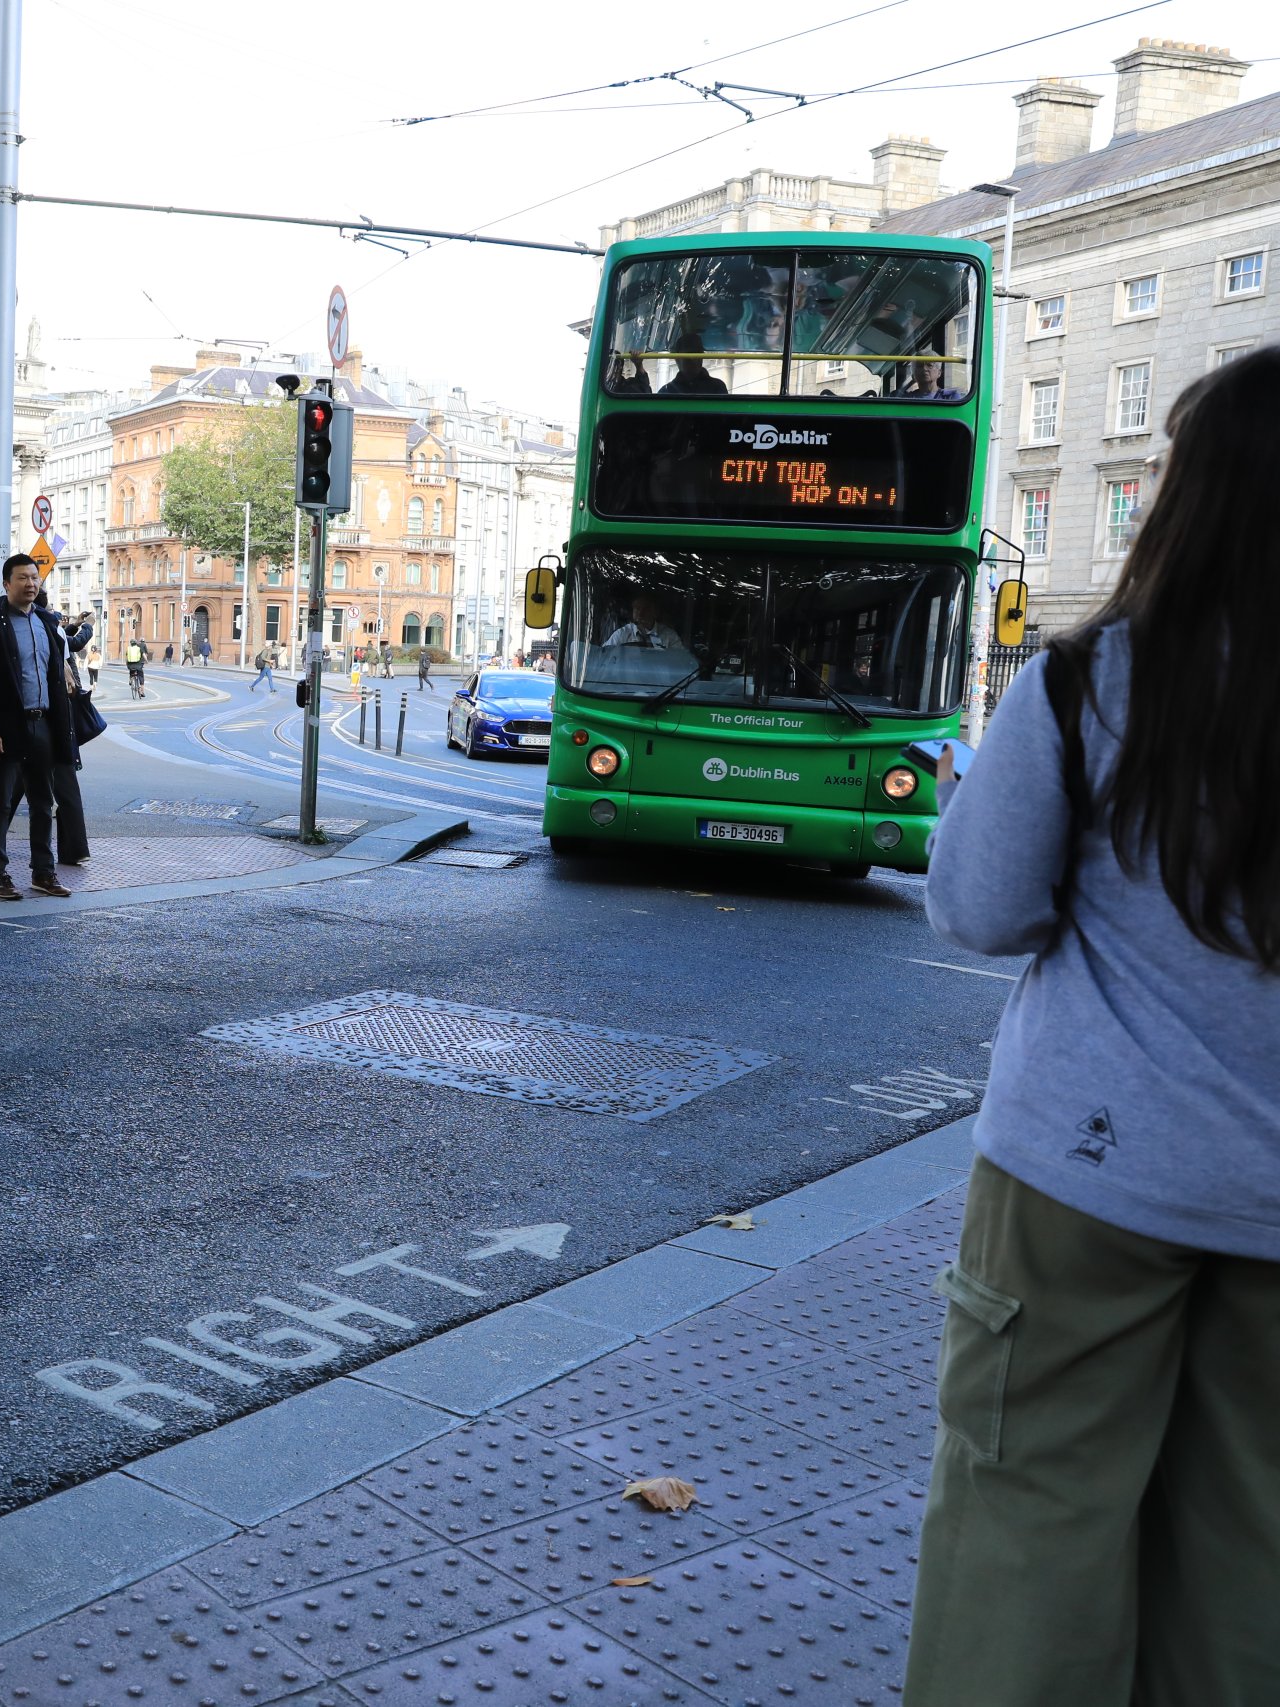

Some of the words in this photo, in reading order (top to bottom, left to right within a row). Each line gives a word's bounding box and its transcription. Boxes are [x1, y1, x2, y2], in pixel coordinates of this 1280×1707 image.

[722, 459, 768, 482] CITY
[776, 462, 827, 484] TOUR
[792, 484, 832, 504] HOP
[838, 486, 868, 505] ON
[710, 713, 731, 723] The
[734, 715, 774, 726] Official
[777, 717, 804, 728] Tour
[730, 765, 771, 779] Dublin
[774, 769, 800, 781] Bus
[824, 775, 863, 787] AX496
[711, 825, 778, 842] 06-D-30496
[33, 1243, 487, 1431] RIGHT
